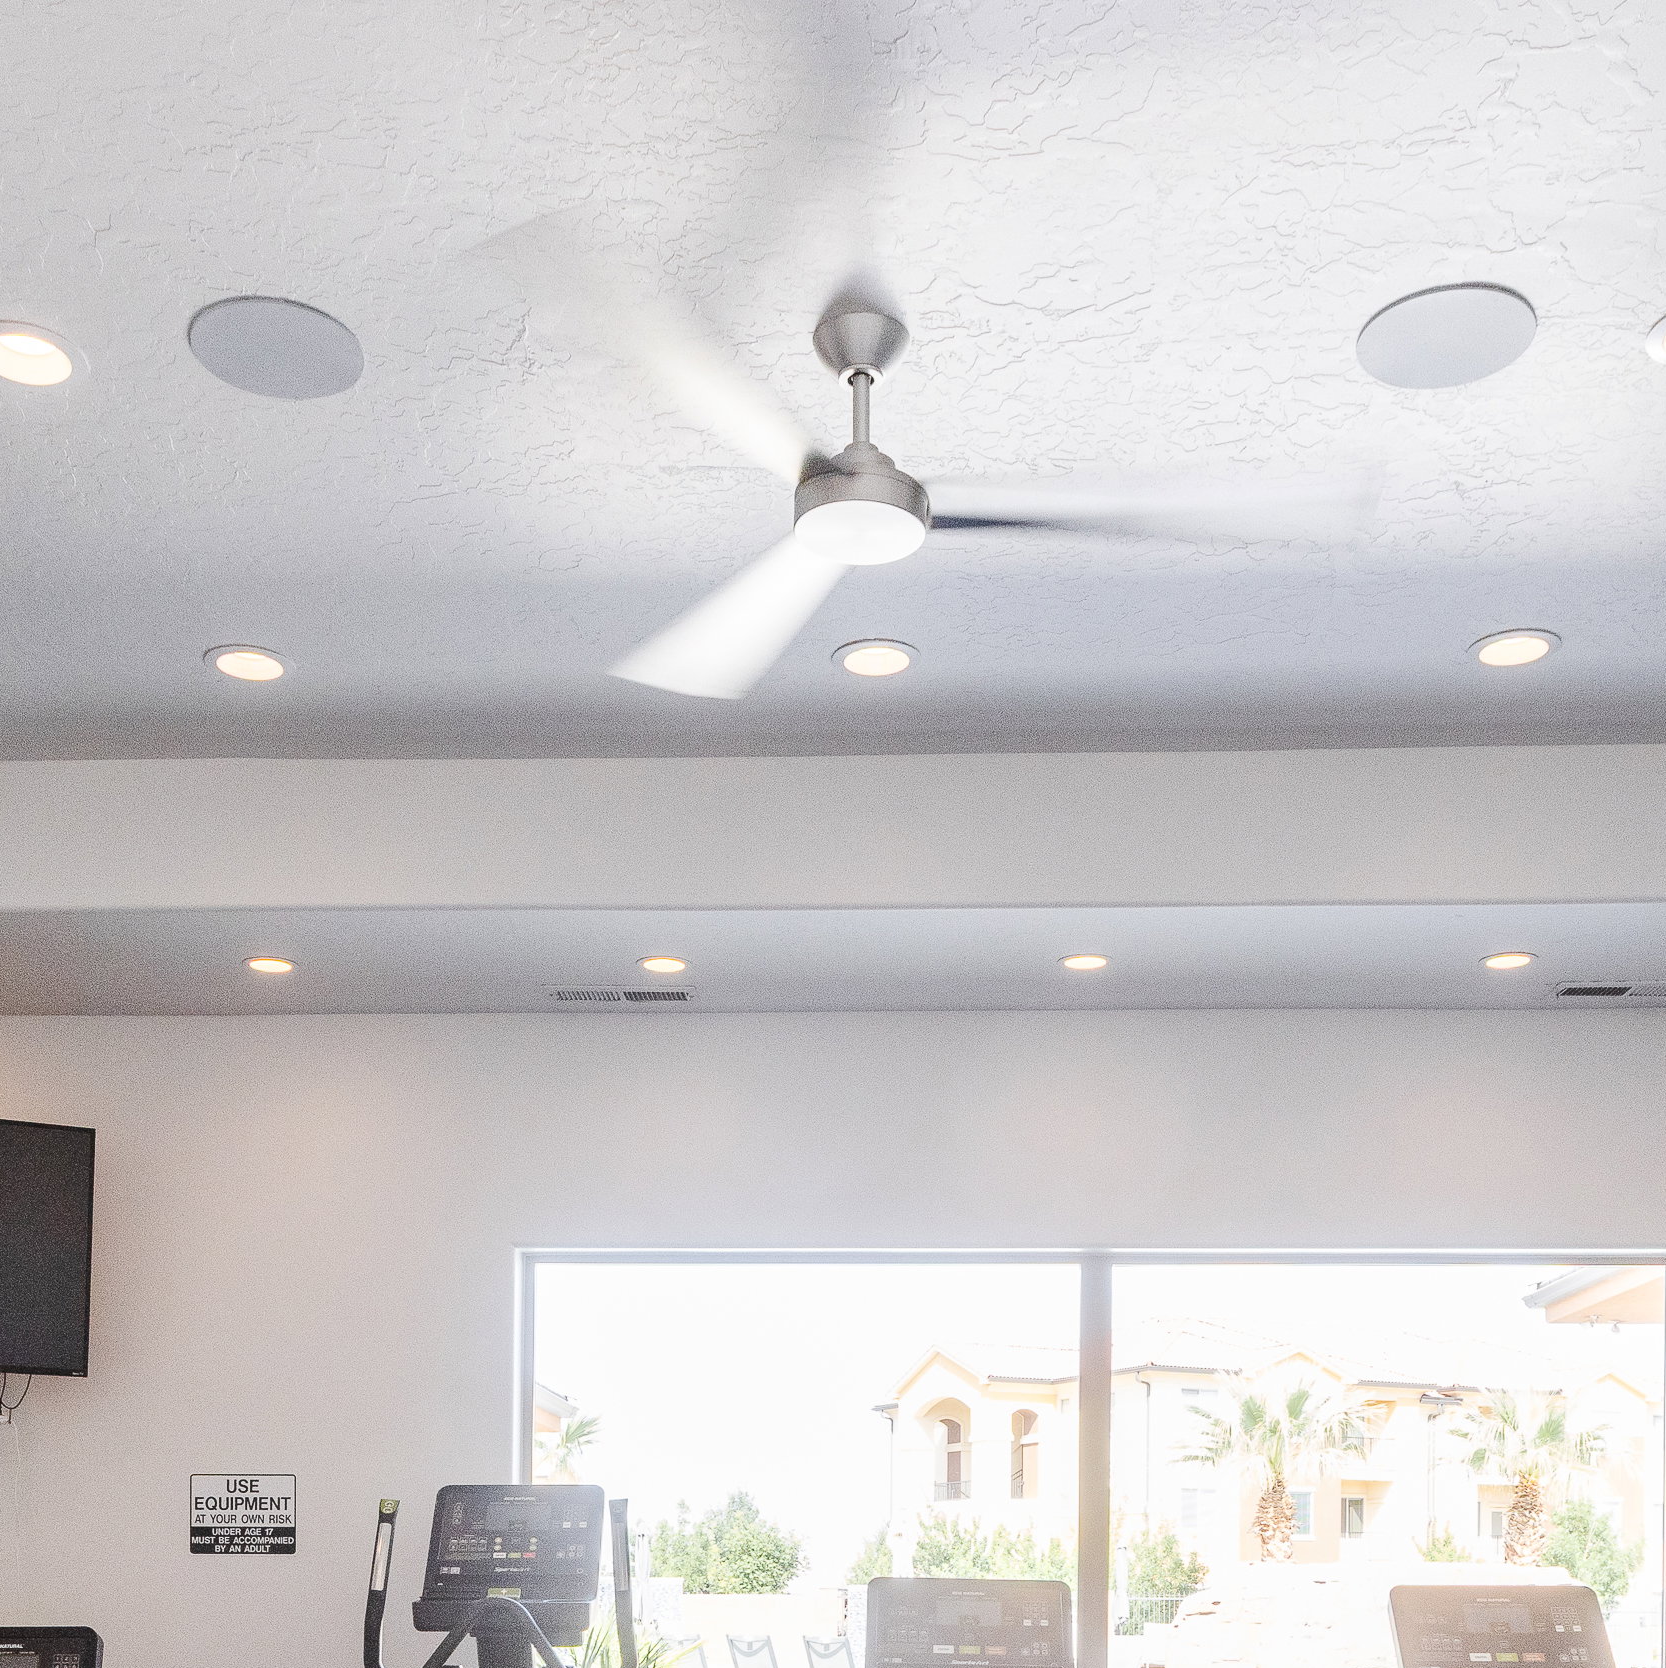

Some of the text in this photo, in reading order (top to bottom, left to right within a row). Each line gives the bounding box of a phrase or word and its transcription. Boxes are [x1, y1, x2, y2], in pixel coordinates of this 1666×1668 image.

[227, 1479, 259, 1493] USE
[195, 1496, 291, 1511] EQUIPMENT
[195, 1514, 292, 1524] AT YOUR OWN RISK
[212, 1528, 273, 1536] UNDER AGE 17
[191, 1536, 294, 1545] MUST BE ACCOMPANIED
